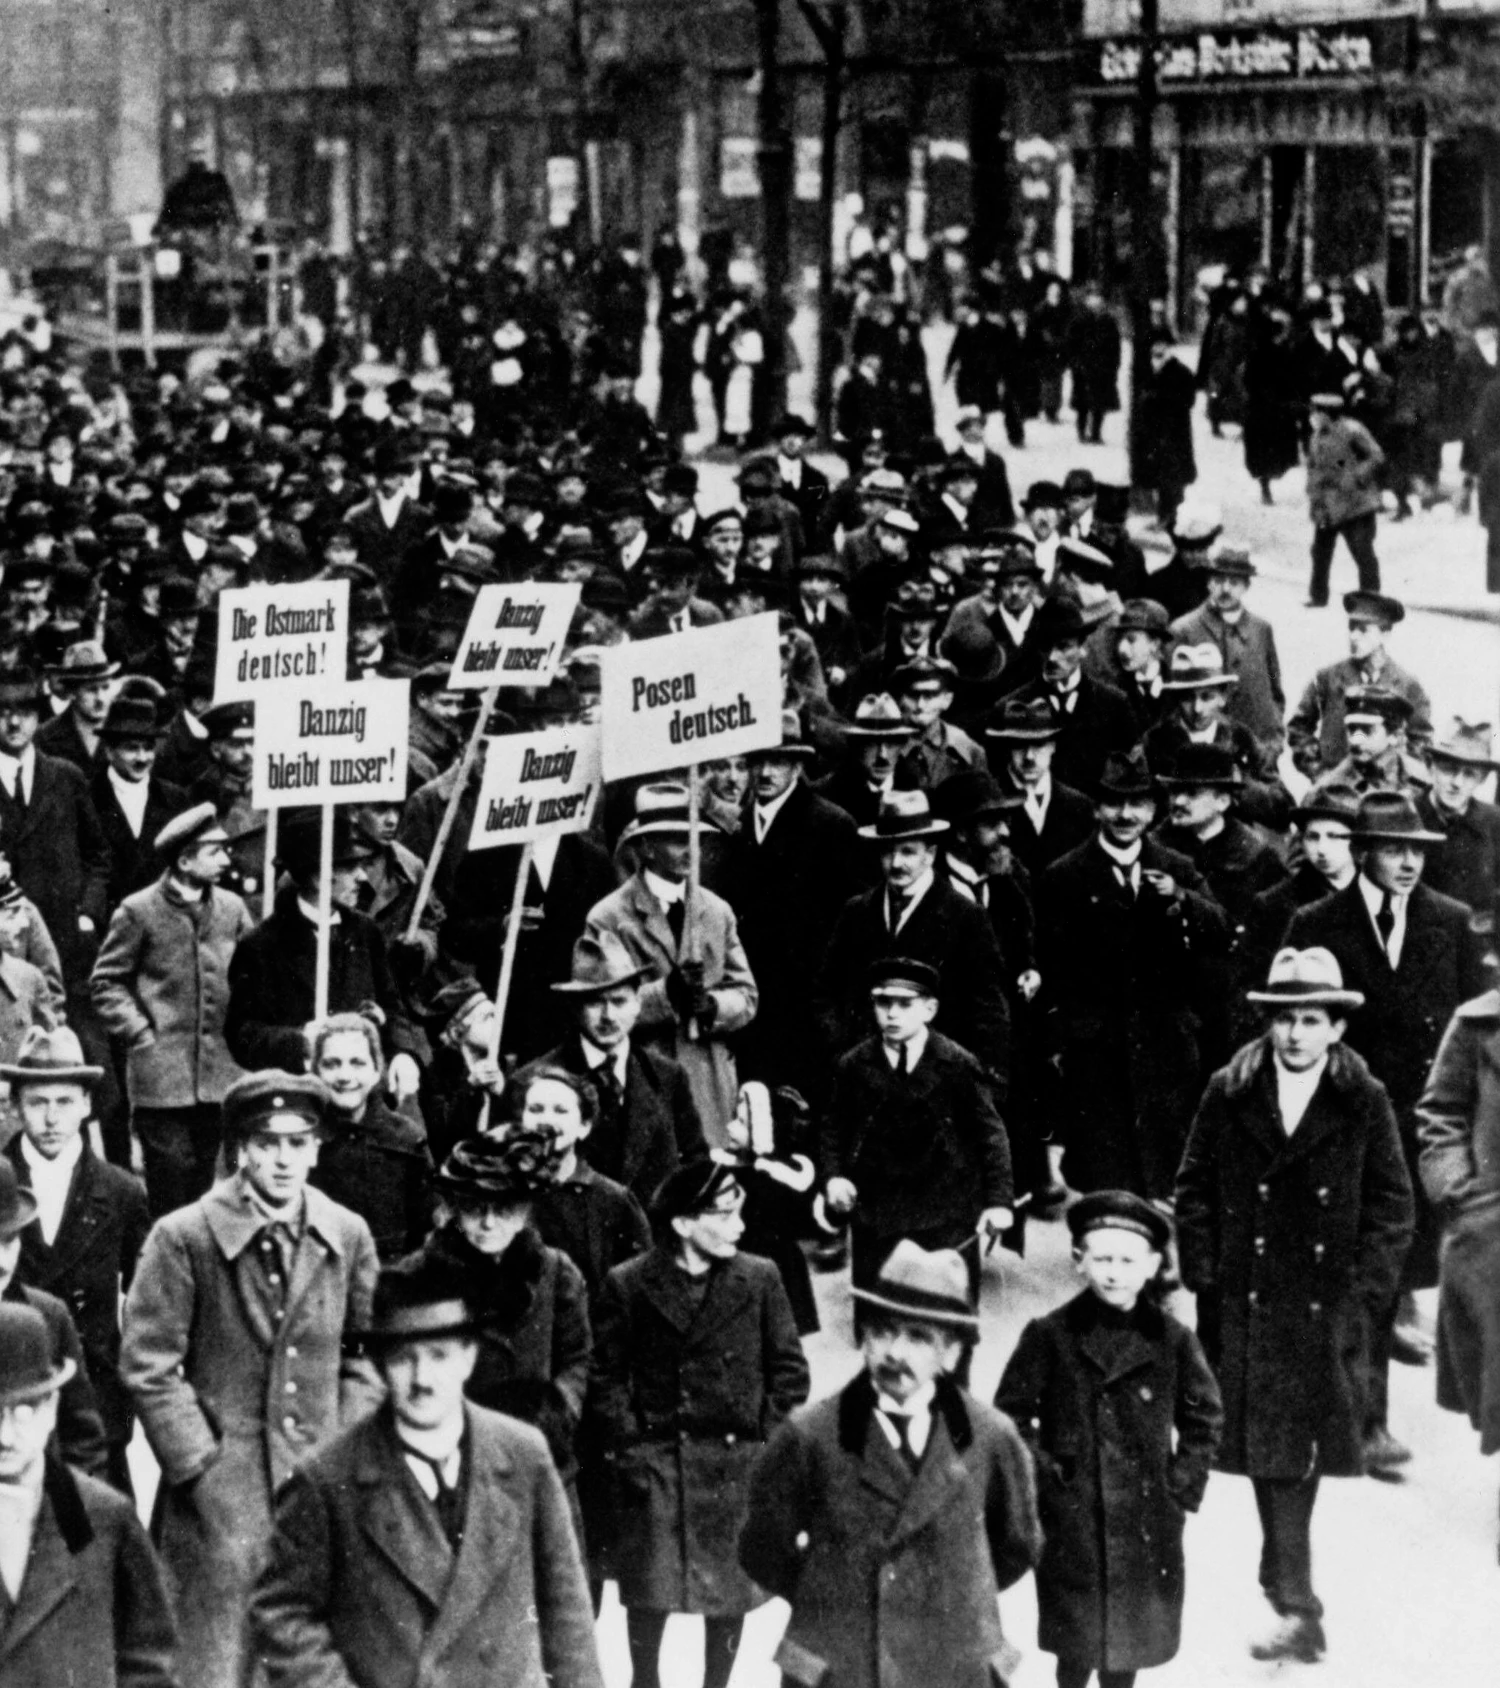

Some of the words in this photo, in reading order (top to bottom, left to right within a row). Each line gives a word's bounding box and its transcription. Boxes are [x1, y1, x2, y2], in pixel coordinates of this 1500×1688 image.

[232, 608, 257, 641] Die
[265, 599, 335, 637] Ostmark
[495, 597, 545, 635] Danzig
[237, 642, 325, 682] deutsch!
[463, 640, 501, 672] bleibt
[502, 642, 555, 671] unser!
[631, 673, 696, 713] Posen
[299, 700, 366, 742] Danzig
[668, 693, 757, 744] deutsch.
[268, 752, 320, 790] bleibt
[330, 747, 395, 786] unser!
[519, 745, 577, 784] Danzig
[485, 795, 532, 832] bleibt
[535, 783, 592, 826] unser!
